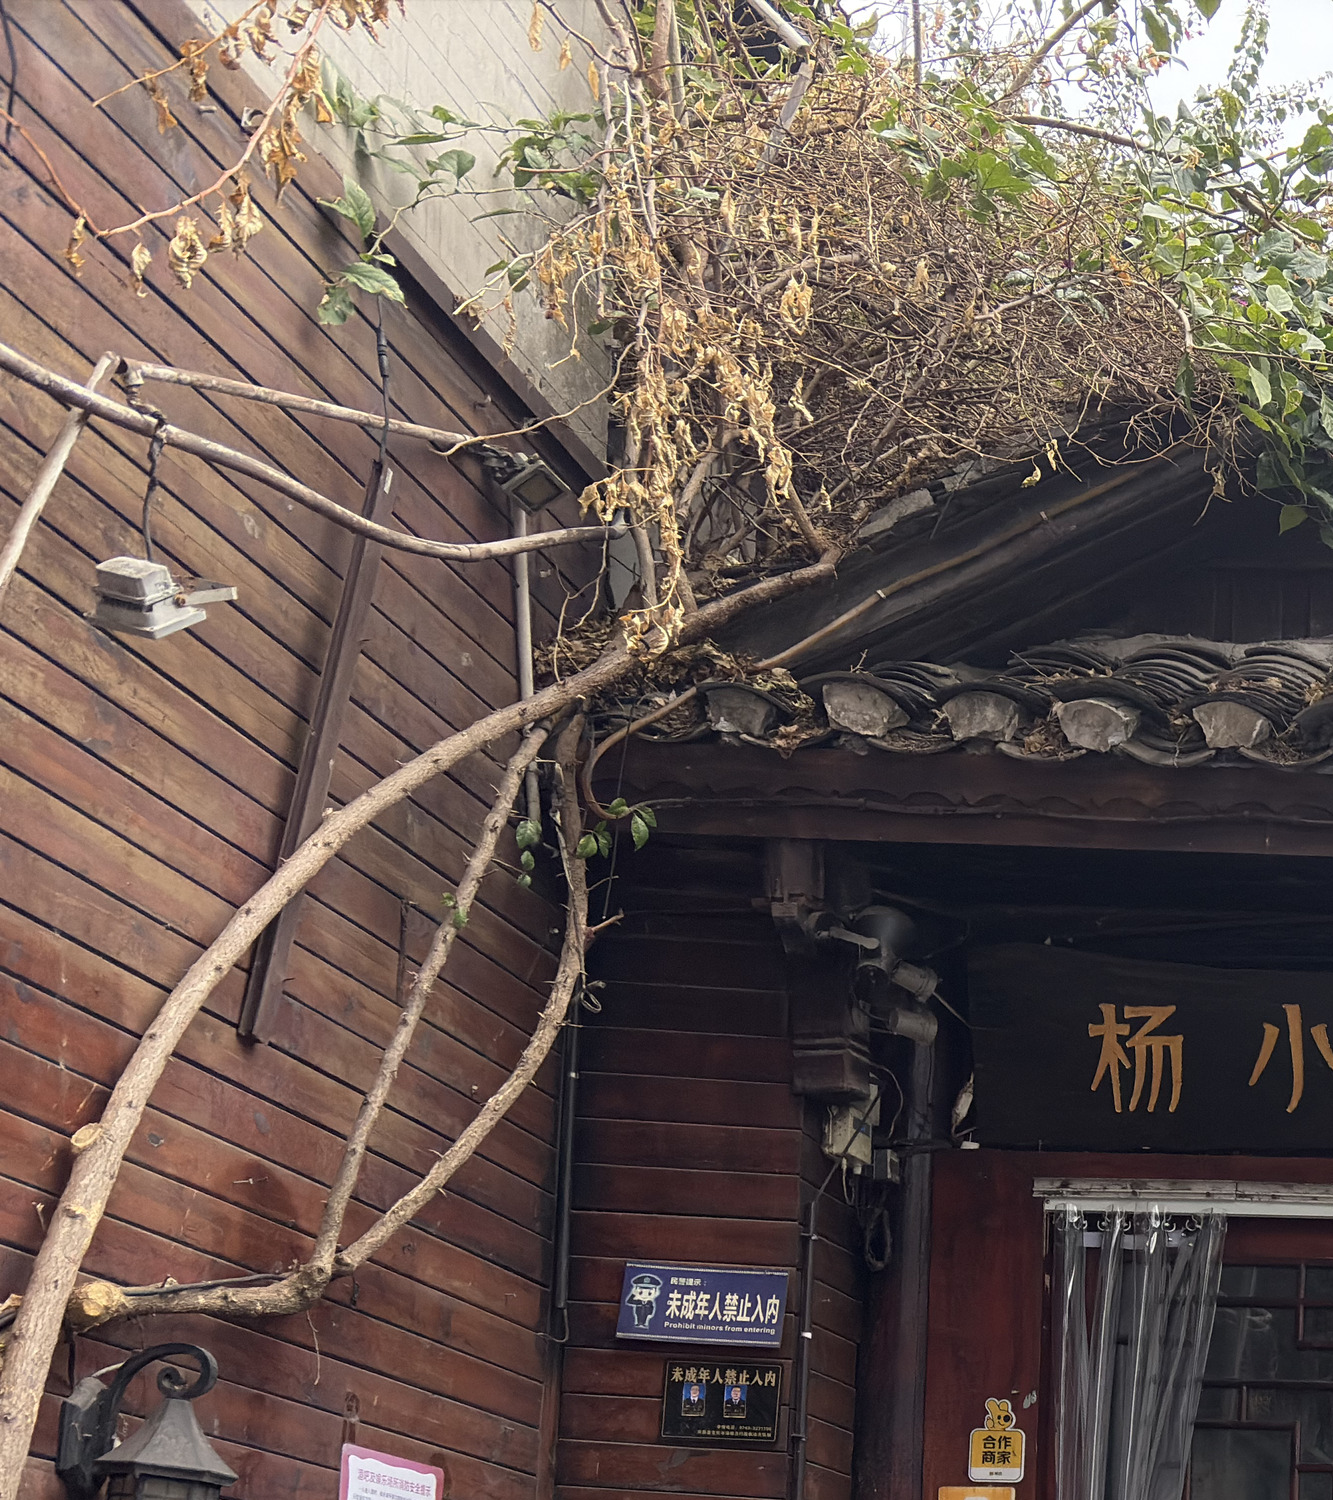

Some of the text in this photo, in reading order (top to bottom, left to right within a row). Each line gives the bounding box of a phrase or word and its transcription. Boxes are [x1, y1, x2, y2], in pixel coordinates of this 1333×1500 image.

[665, 1289, 780, 1325] 未成年人禁止入内
[664, 1321, 695, 1330] Prohibit
[743, 1327, 776, 1335] entering
[670, 1366, 776, 1387] 未成年人禁止入内
[982, 1435, 1012, 1450] 合作
[981, 1450, 1012, 1465] 商家
